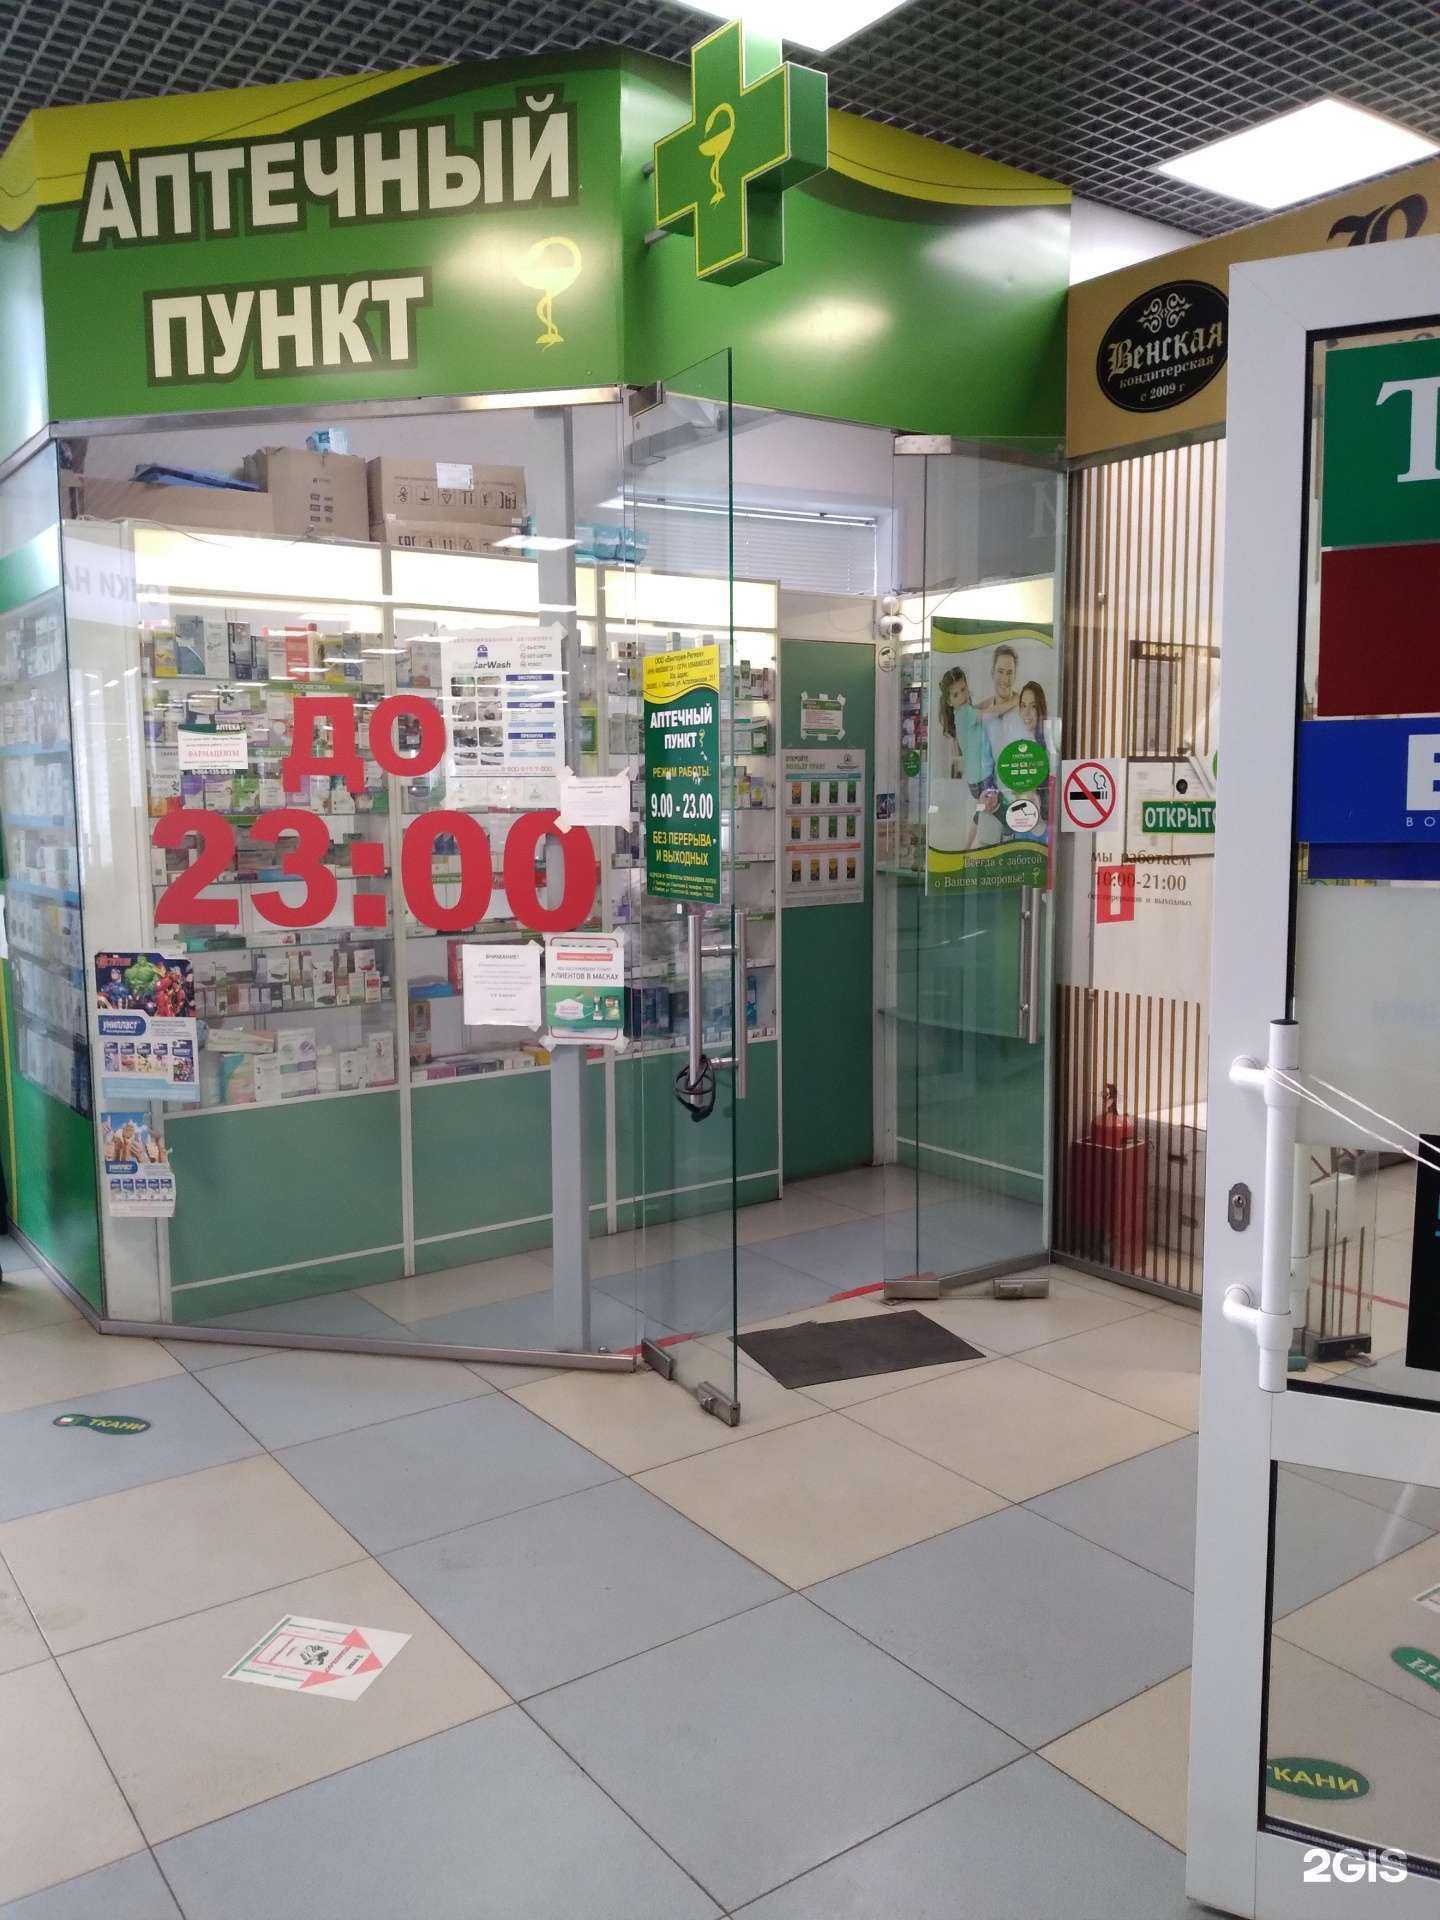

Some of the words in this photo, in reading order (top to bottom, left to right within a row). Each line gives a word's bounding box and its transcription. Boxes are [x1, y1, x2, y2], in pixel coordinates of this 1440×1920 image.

[82, 93, 571, 243] АПТЕЧНЫЙ
[151, 275, 424, 378] ПУНКТ
[1107, 321, 1224, 382] Венская
[1120, 355, 1215, 389] кондитерская
[1150, 382, 1176, 399] 2009
[650, 703, 713, 729] АПТЕЧНЫЙ
[664, 732, 698, 749] ПУНКТ
[652, 767, 678, 778] РЕЖИМ
[651, 792, 673, 818] 9.00
[682, 792, 714, 819] 23.00
[1145, 806, 1217, 828] ОТКРЫТ
[652, 830, 667, 845] БЕЗ
[668, 831, 712, 848] ПЕРЕРЫВА
[656, 849, 662, 862] И
[663, 849, 709, 866] ВЫХОДНЫХ
[151, 808, 597, 932] 23:00
[944, 875, 978, 888] Вашем
[980, 872, 1025, 887] здоровье!
[551, 972, 585, 981] КЛИЕНТОВ
[592, 972, 619, 981] МАСКАХ
[90, 1418, 147, 1431] ТКАНИ
[1268, 1765, 1359, 1793] КАНИ
